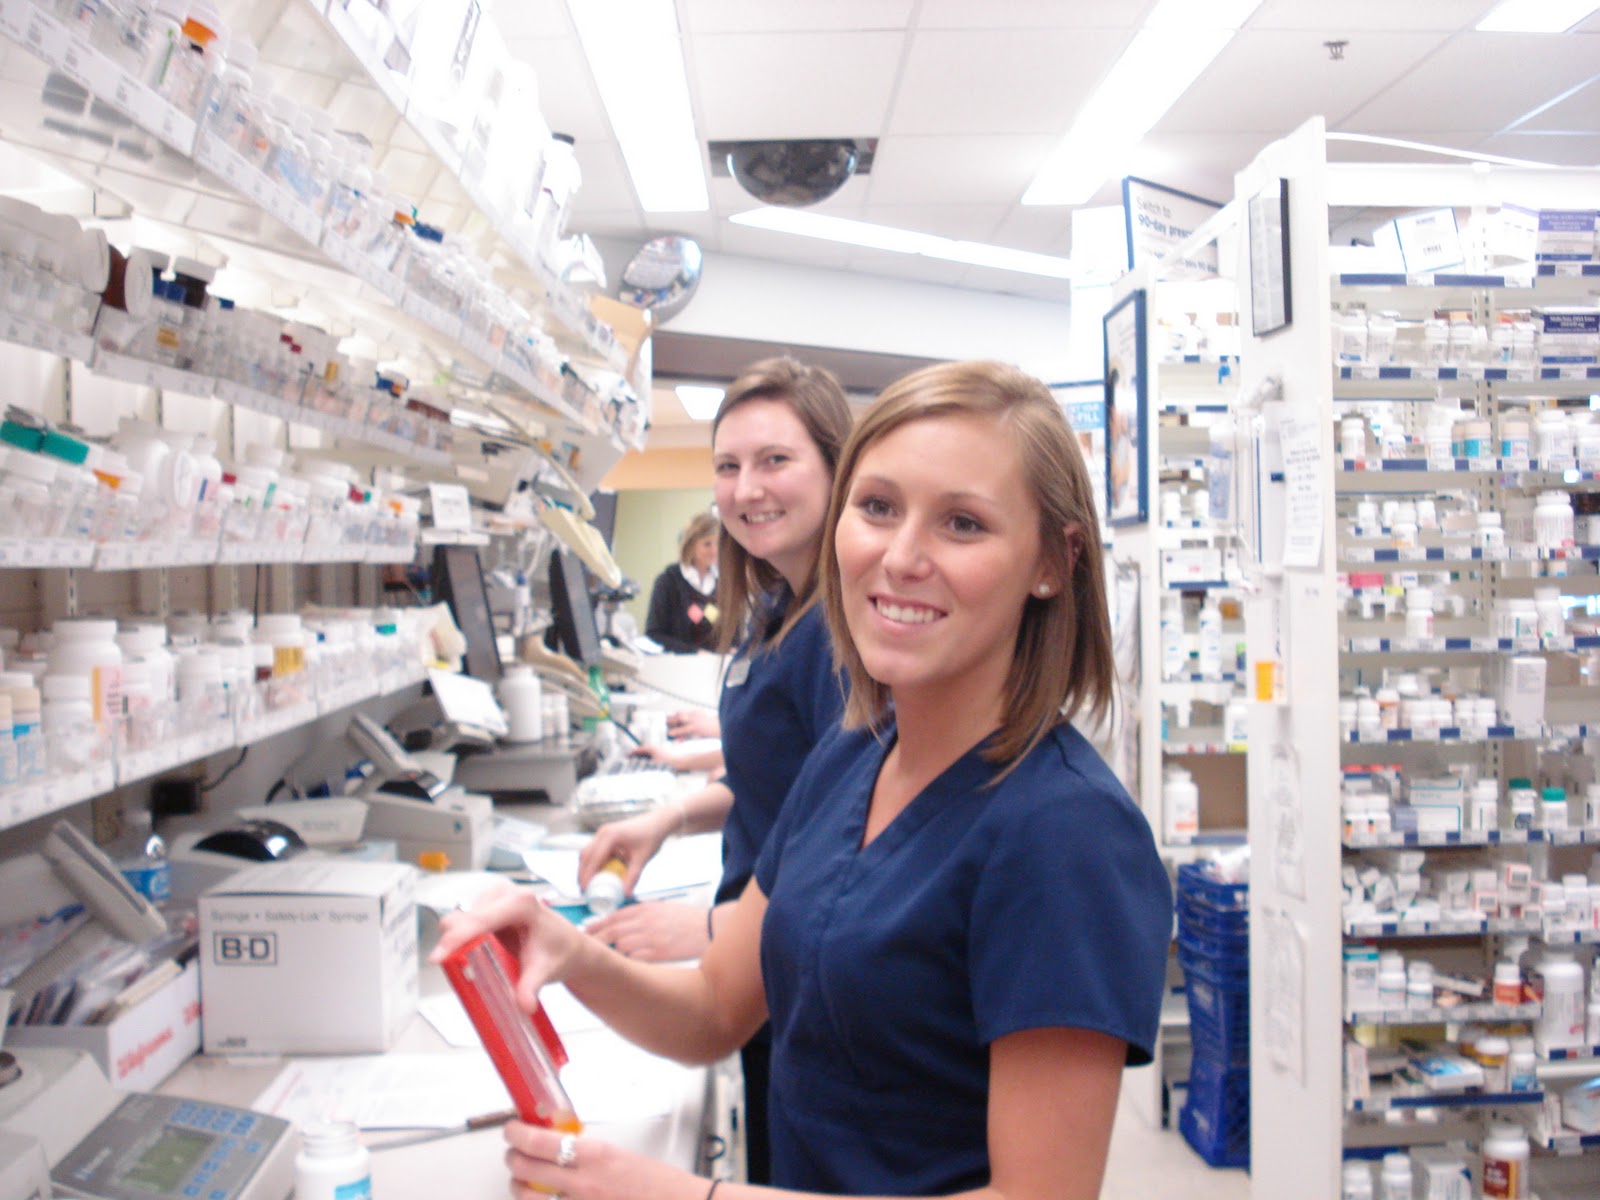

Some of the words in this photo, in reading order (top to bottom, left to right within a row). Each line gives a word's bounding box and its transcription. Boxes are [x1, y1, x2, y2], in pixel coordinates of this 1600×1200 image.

[1136, 196, 1161, 214] Switch
[1162, 205, 1172, 219] to
[1138, 213, 1167, 236] 90-day
[211, 911, 250, 923] Syringe
[329, 911, 369, 923] Syringe
[221, 937, 271, 960] B-D
